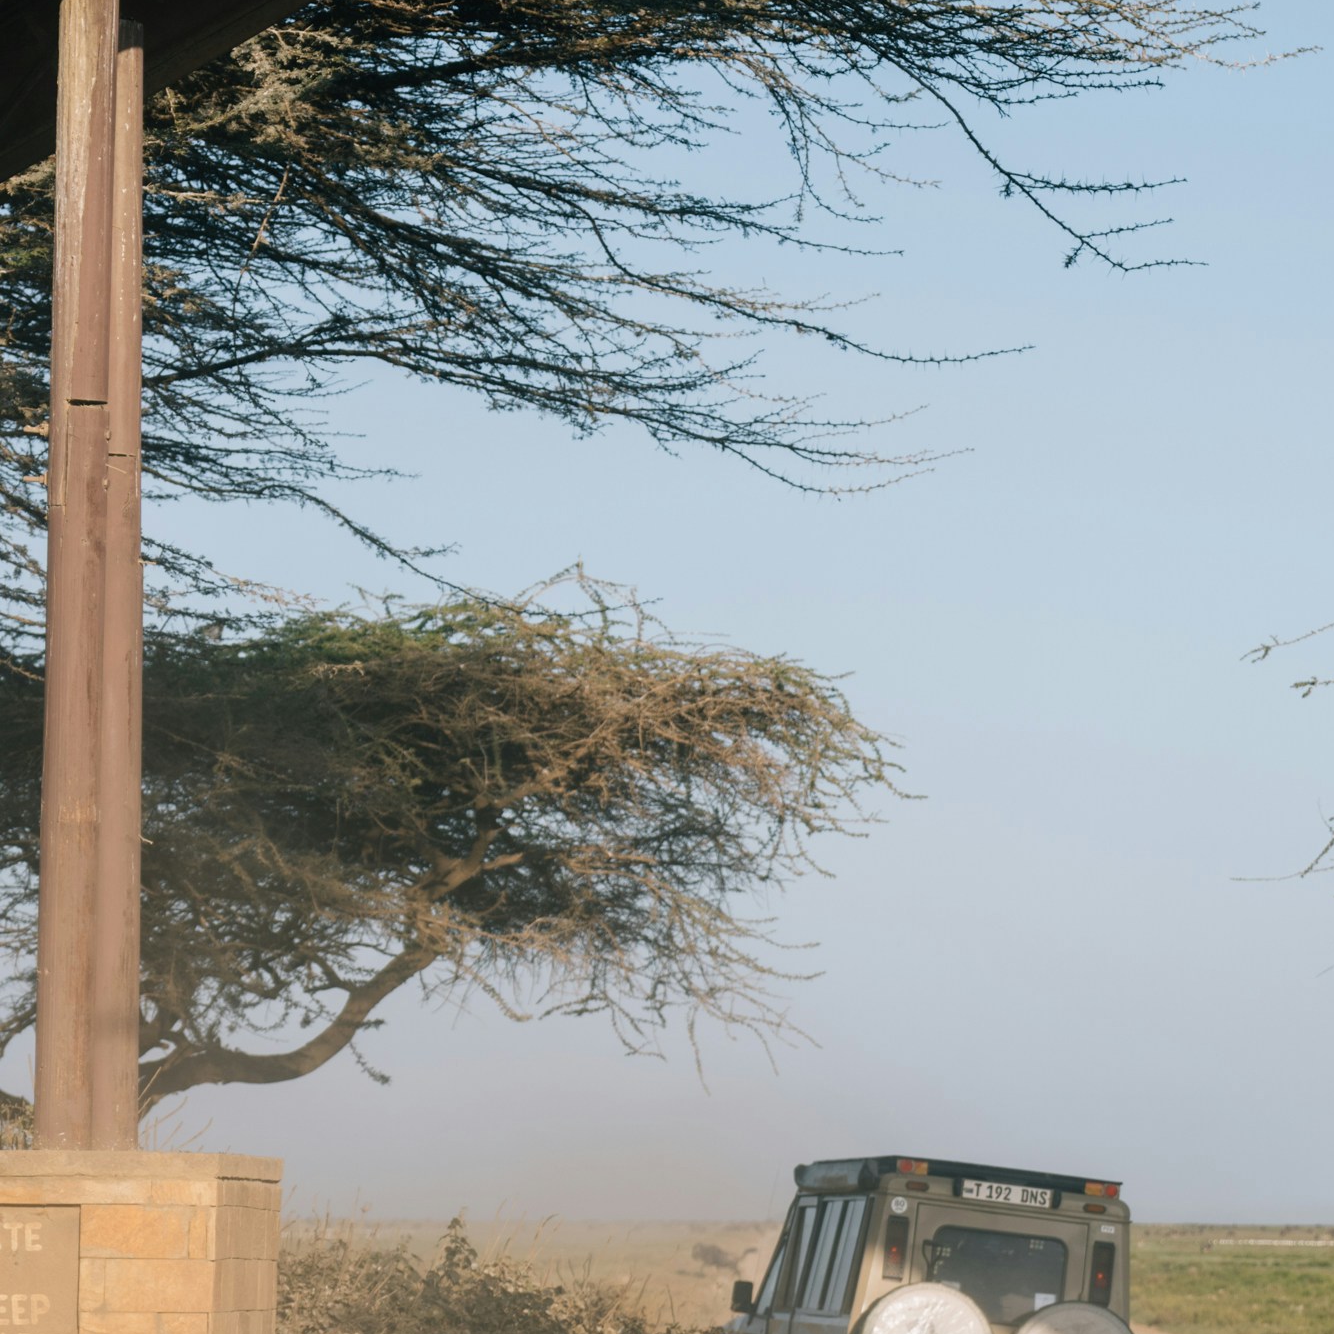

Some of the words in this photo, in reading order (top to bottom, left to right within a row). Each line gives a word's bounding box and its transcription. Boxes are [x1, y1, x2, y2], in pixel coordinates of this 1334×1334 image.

[974, 1182, 982, 1198] T
[986, 1184, 1012, 1202] 192
[1021, 1188, 1047, 1206] DNS
[0, 1222, 43, 1251] TE
